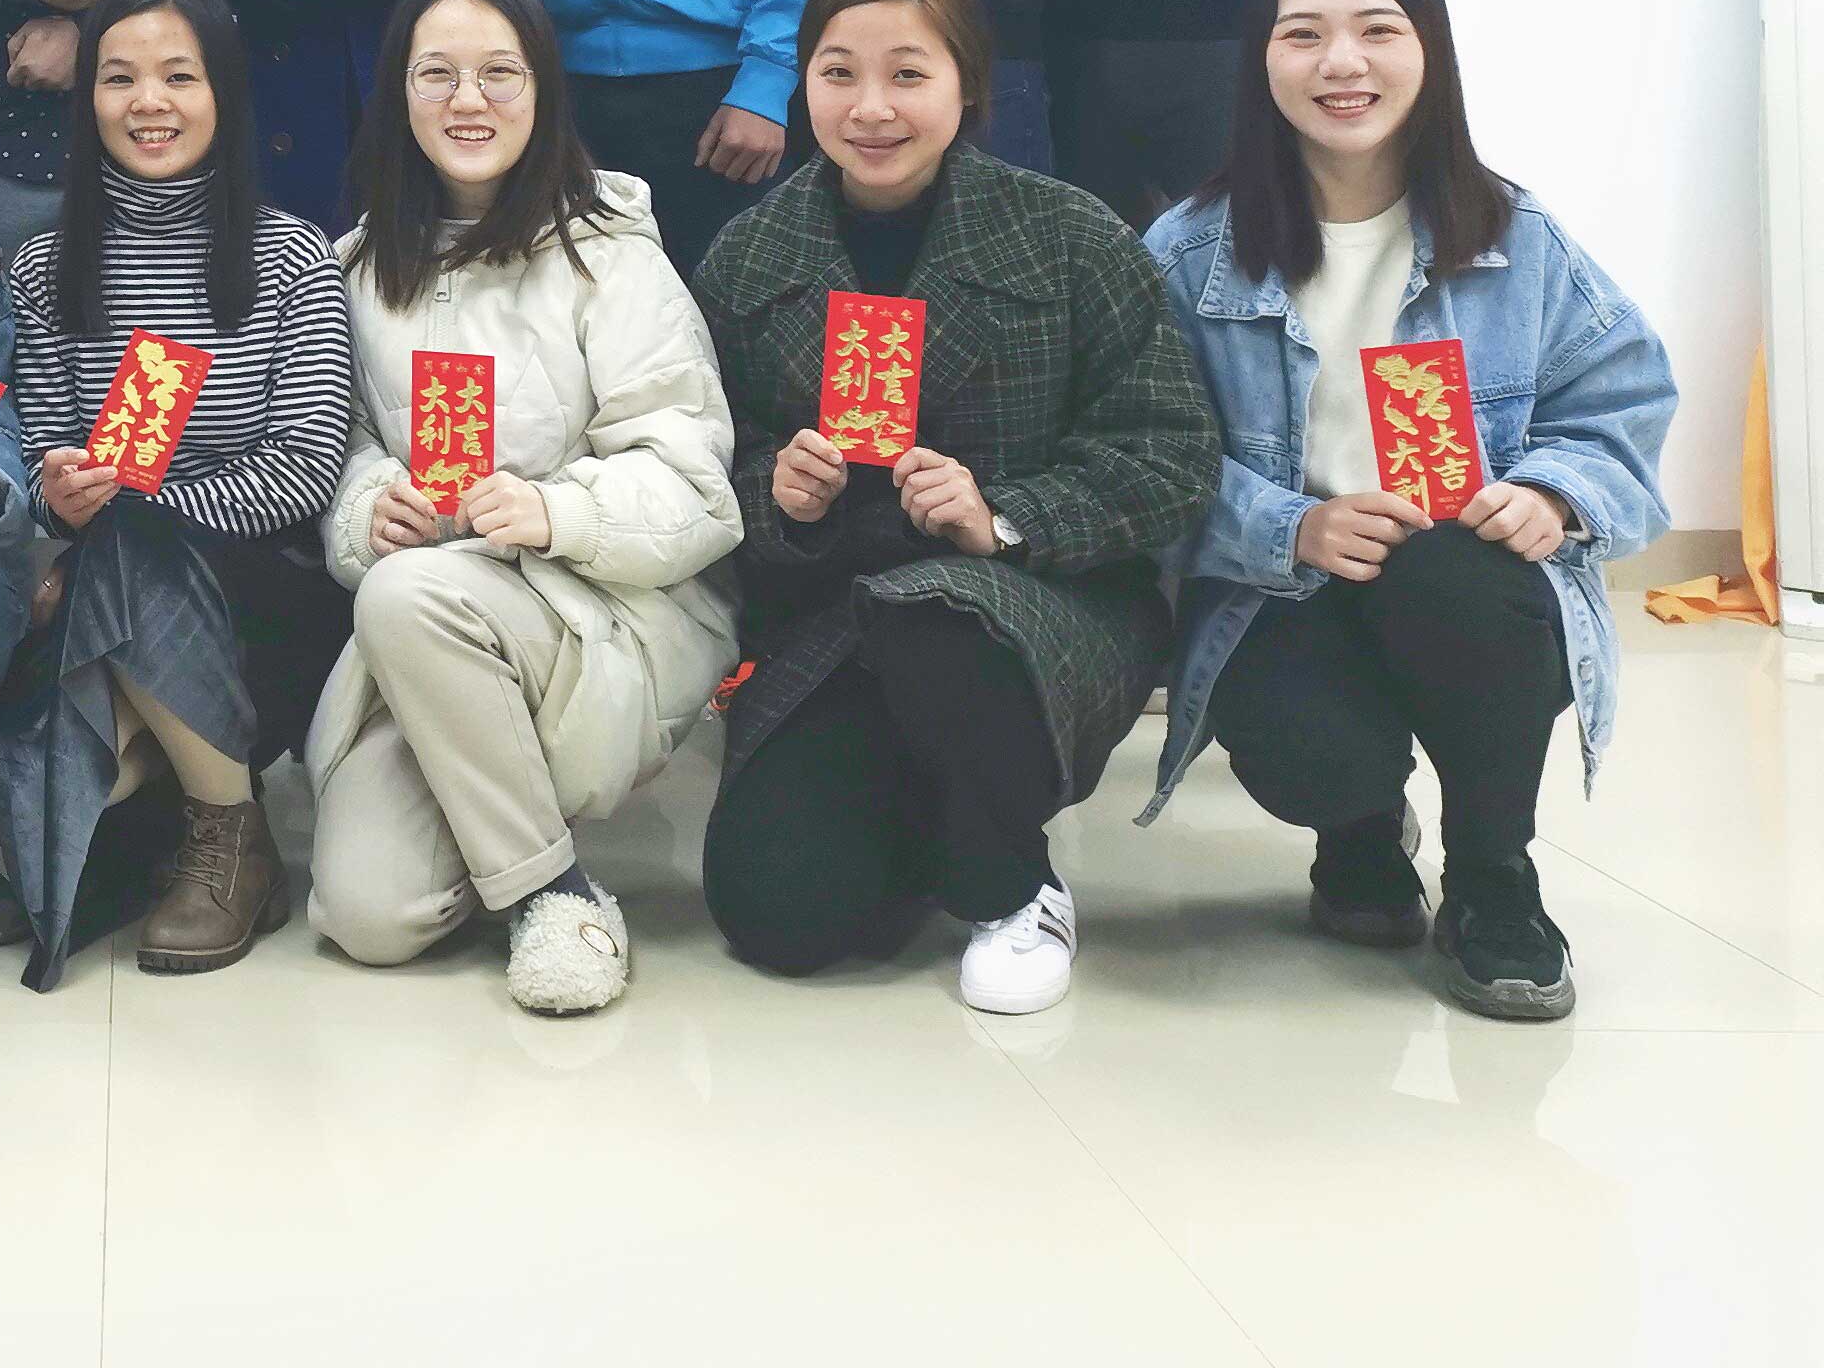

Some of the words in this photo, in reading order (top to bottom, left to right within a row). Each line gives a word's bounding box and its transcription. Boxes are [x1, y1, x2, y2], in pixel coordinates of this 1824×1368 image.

[830, 319, 872, 402] 大利
[873, 321, 915, 405] 大吉
[92, 407, 136, 466] 大利
[133, 410, 171, 467] 大吉
[416, 376, 452, 455] 大利
[453, 376, 489, 457] 大吉
[1429, 422, 1471, 492] 大吉
